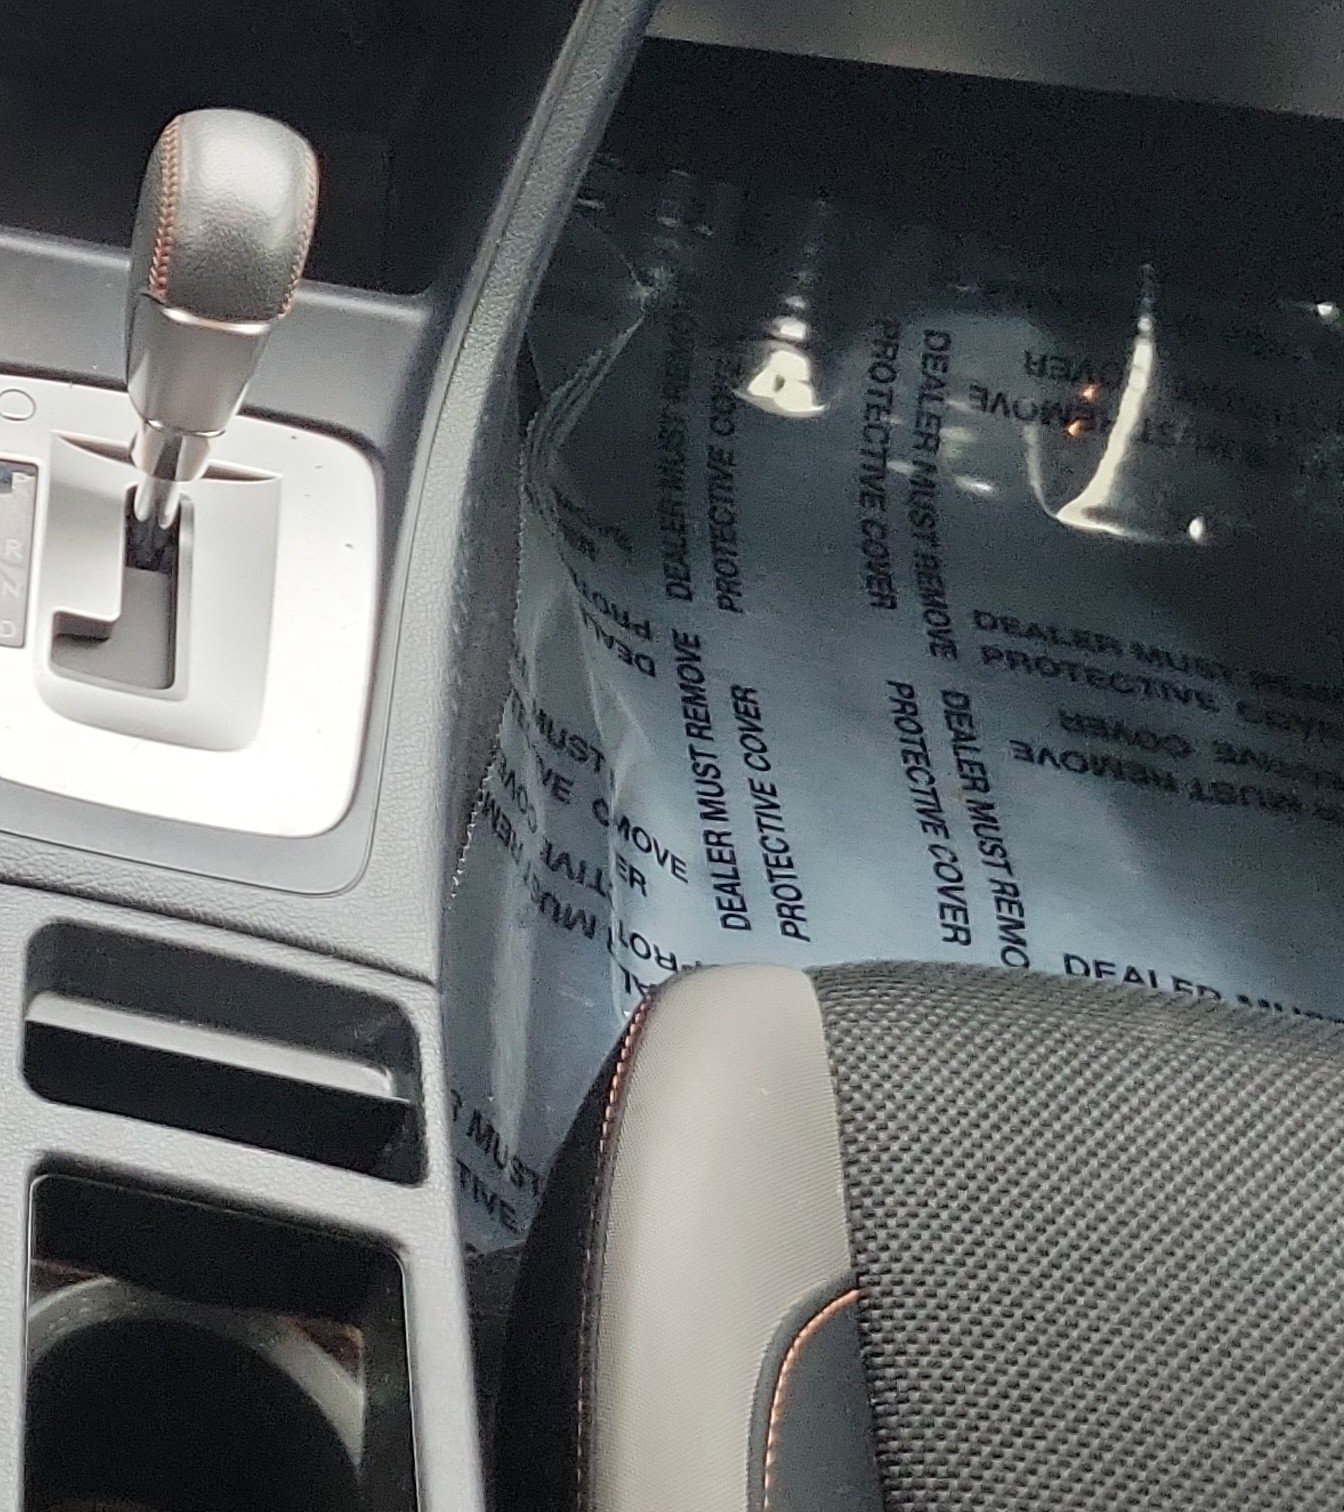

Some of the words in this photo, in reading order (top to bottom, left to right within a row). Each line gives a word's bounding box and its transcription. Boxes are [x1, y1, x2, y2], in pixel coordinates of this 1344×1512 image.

[671, 625, 716, 743] REMOVE
[729, 683, 774, 774] COVER
[687, 742, 732, 824] MUST
[939, 689, 992, 795] DEALER
[747, 776, 814, 944] PROTECTIVE
[885, 678, 952, 841] PROTECTIVE
[927, 842, 973, 948] COVER
[964, 797, 1016, 879] MUST
[701, 828, 754, 934] DEALER
[987, 877, 1032, 971] REMO
